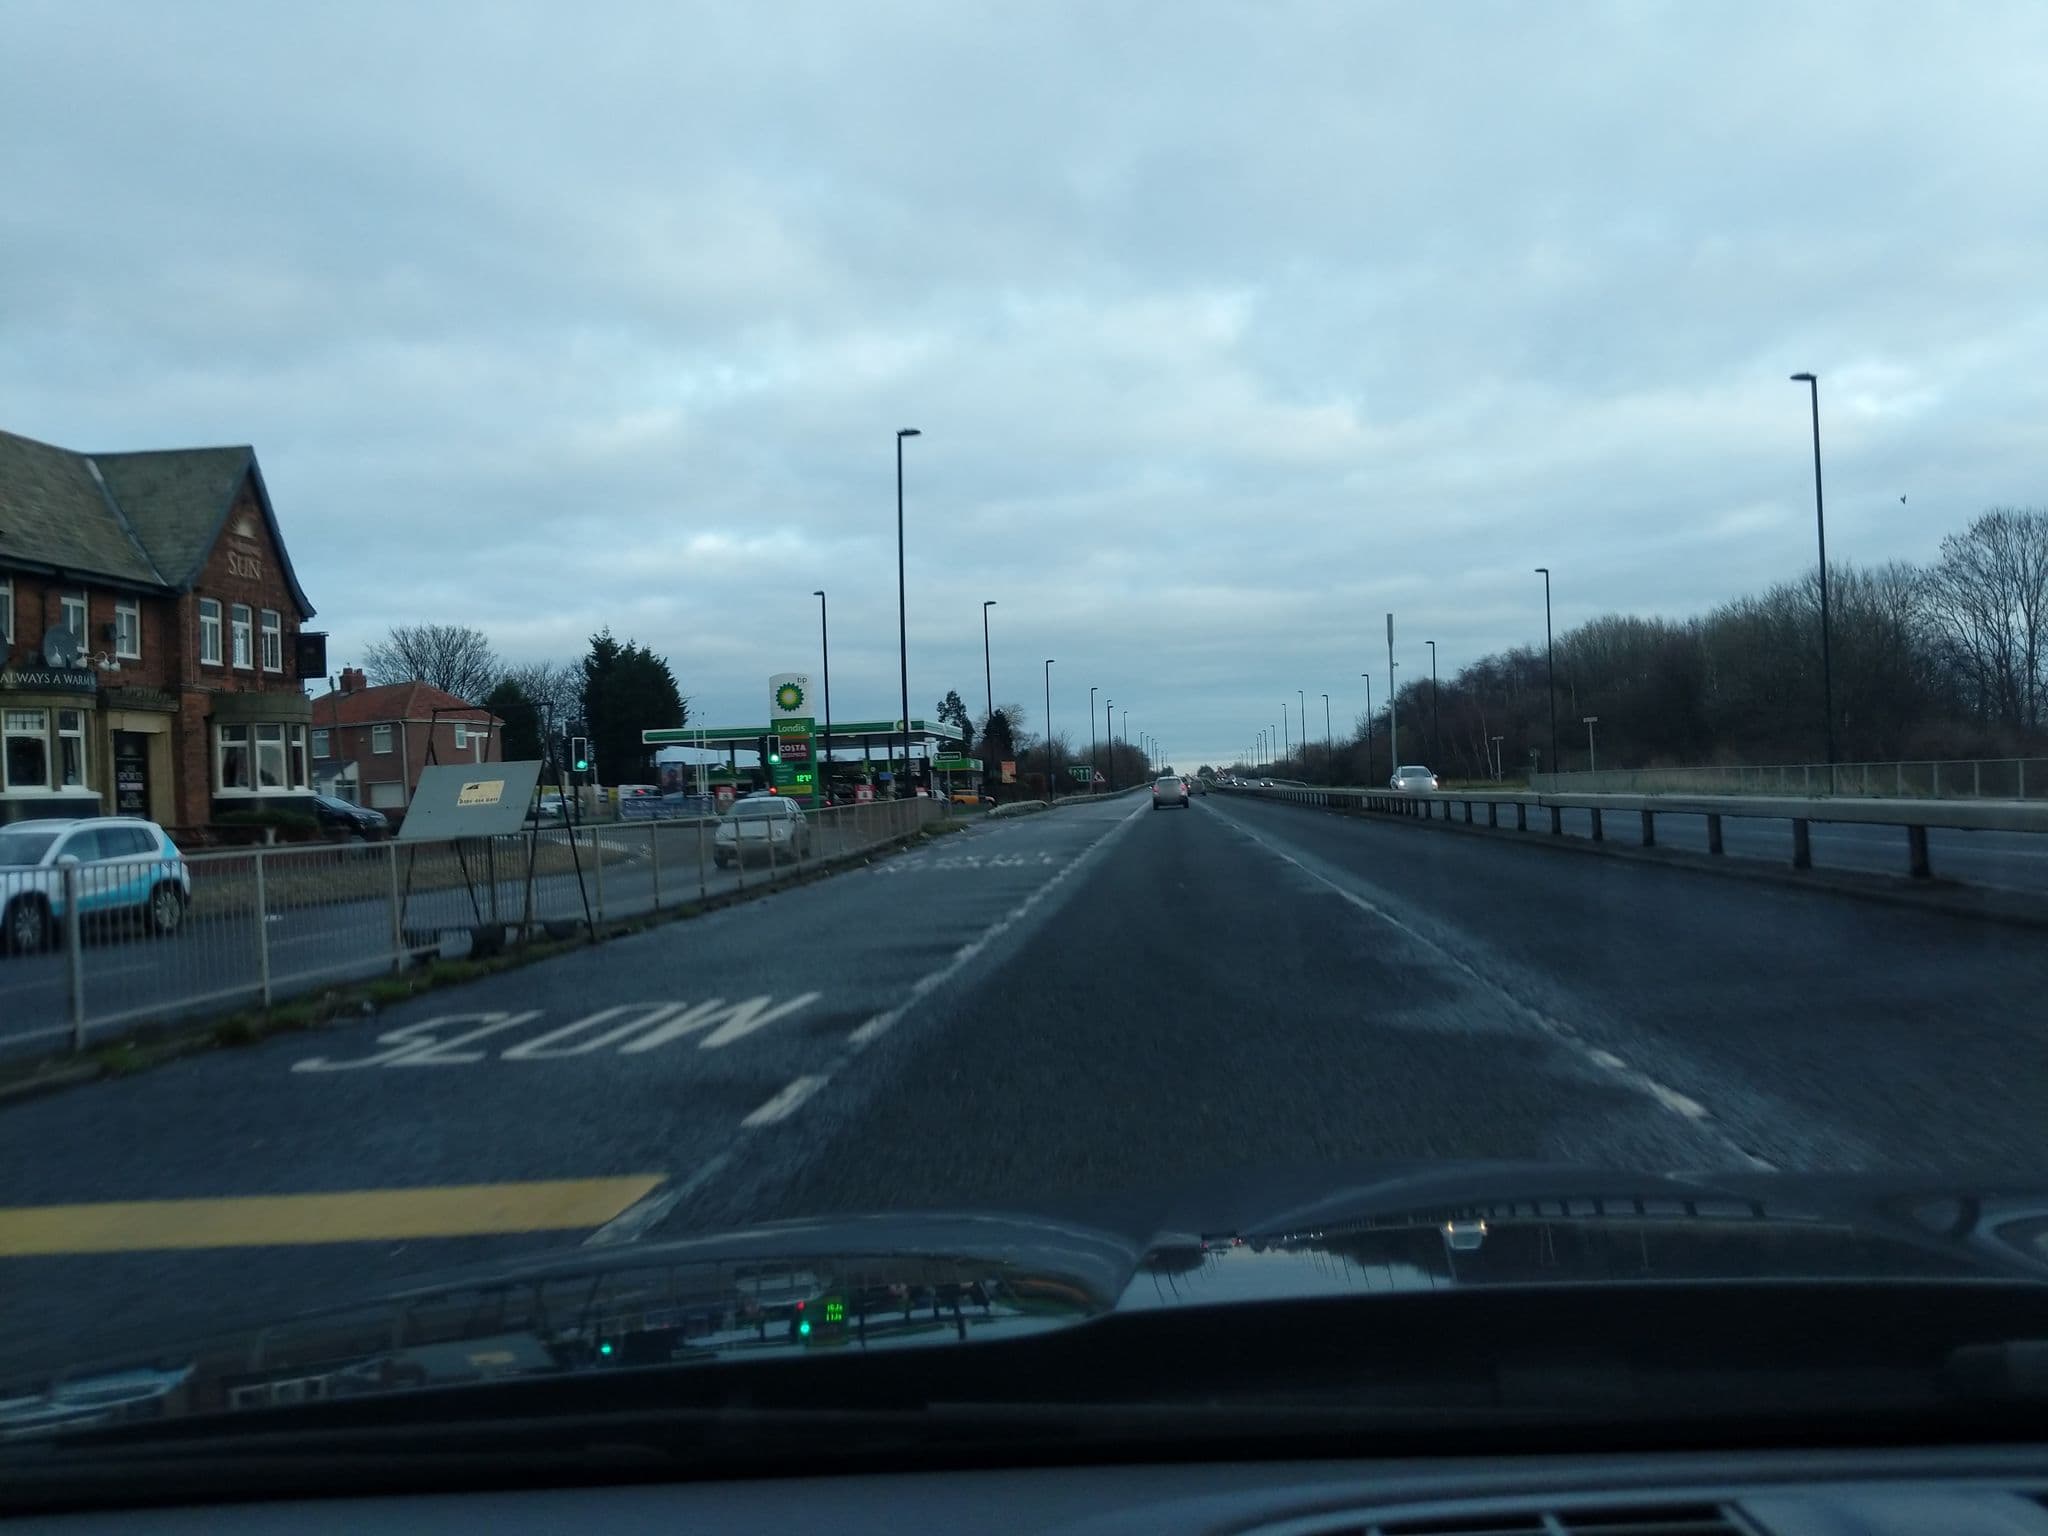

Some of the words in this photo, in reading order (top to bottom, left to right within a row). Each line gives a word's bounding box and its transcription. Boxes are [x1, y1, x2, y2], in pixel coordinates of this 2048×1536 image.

[227, 551, 262, 579] SUN
[0, 672, 50, 684] ALWAYS
[53, 674, 61, 684] A
[63, 674, 89, 686] WARM
[797, 676, 808, 684] bp
[778, 724, 806, 733] Londis
[780, 744, 806, 752] COSTA
[291, 990, 822, 1072] SLOW
